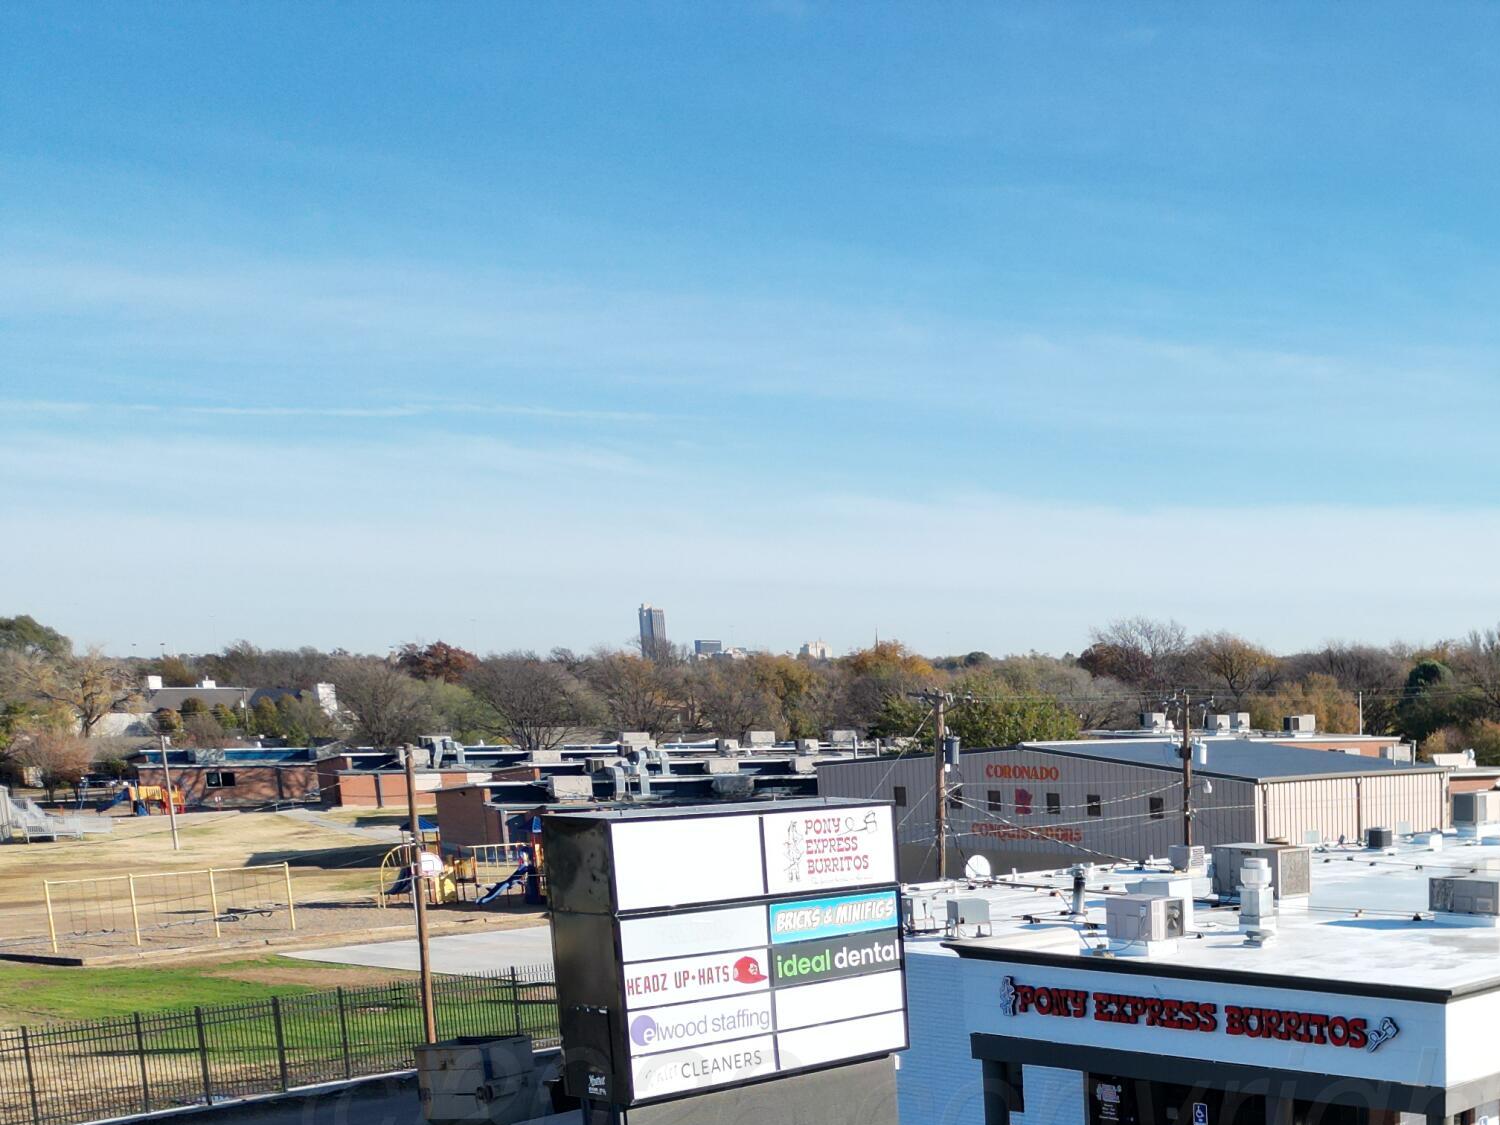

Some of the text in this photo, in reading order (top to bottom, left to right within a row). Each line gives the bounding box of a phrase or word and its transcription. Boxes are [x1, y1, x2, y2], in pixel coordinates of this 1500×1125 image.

[985, 763, 1060, 781] CORONADO
[804, 817, 841, 835] PONY
[805, 836, 858, 855] EXPRESS
[806, 854, 869, 875] BURRITOS
[776, 897, 895, 933] BRICKS & MINIFIGS
[777, 939, 900, 978] ideal dental
[626, 973, 669, 996] HEADZ
[643, 1008, 770, 1044] elwood staffing
[1015, 984, 1368, 1049] PONY EXPRESS BURRITOS
[681, 1050, 762, 1078] CLEANERS
